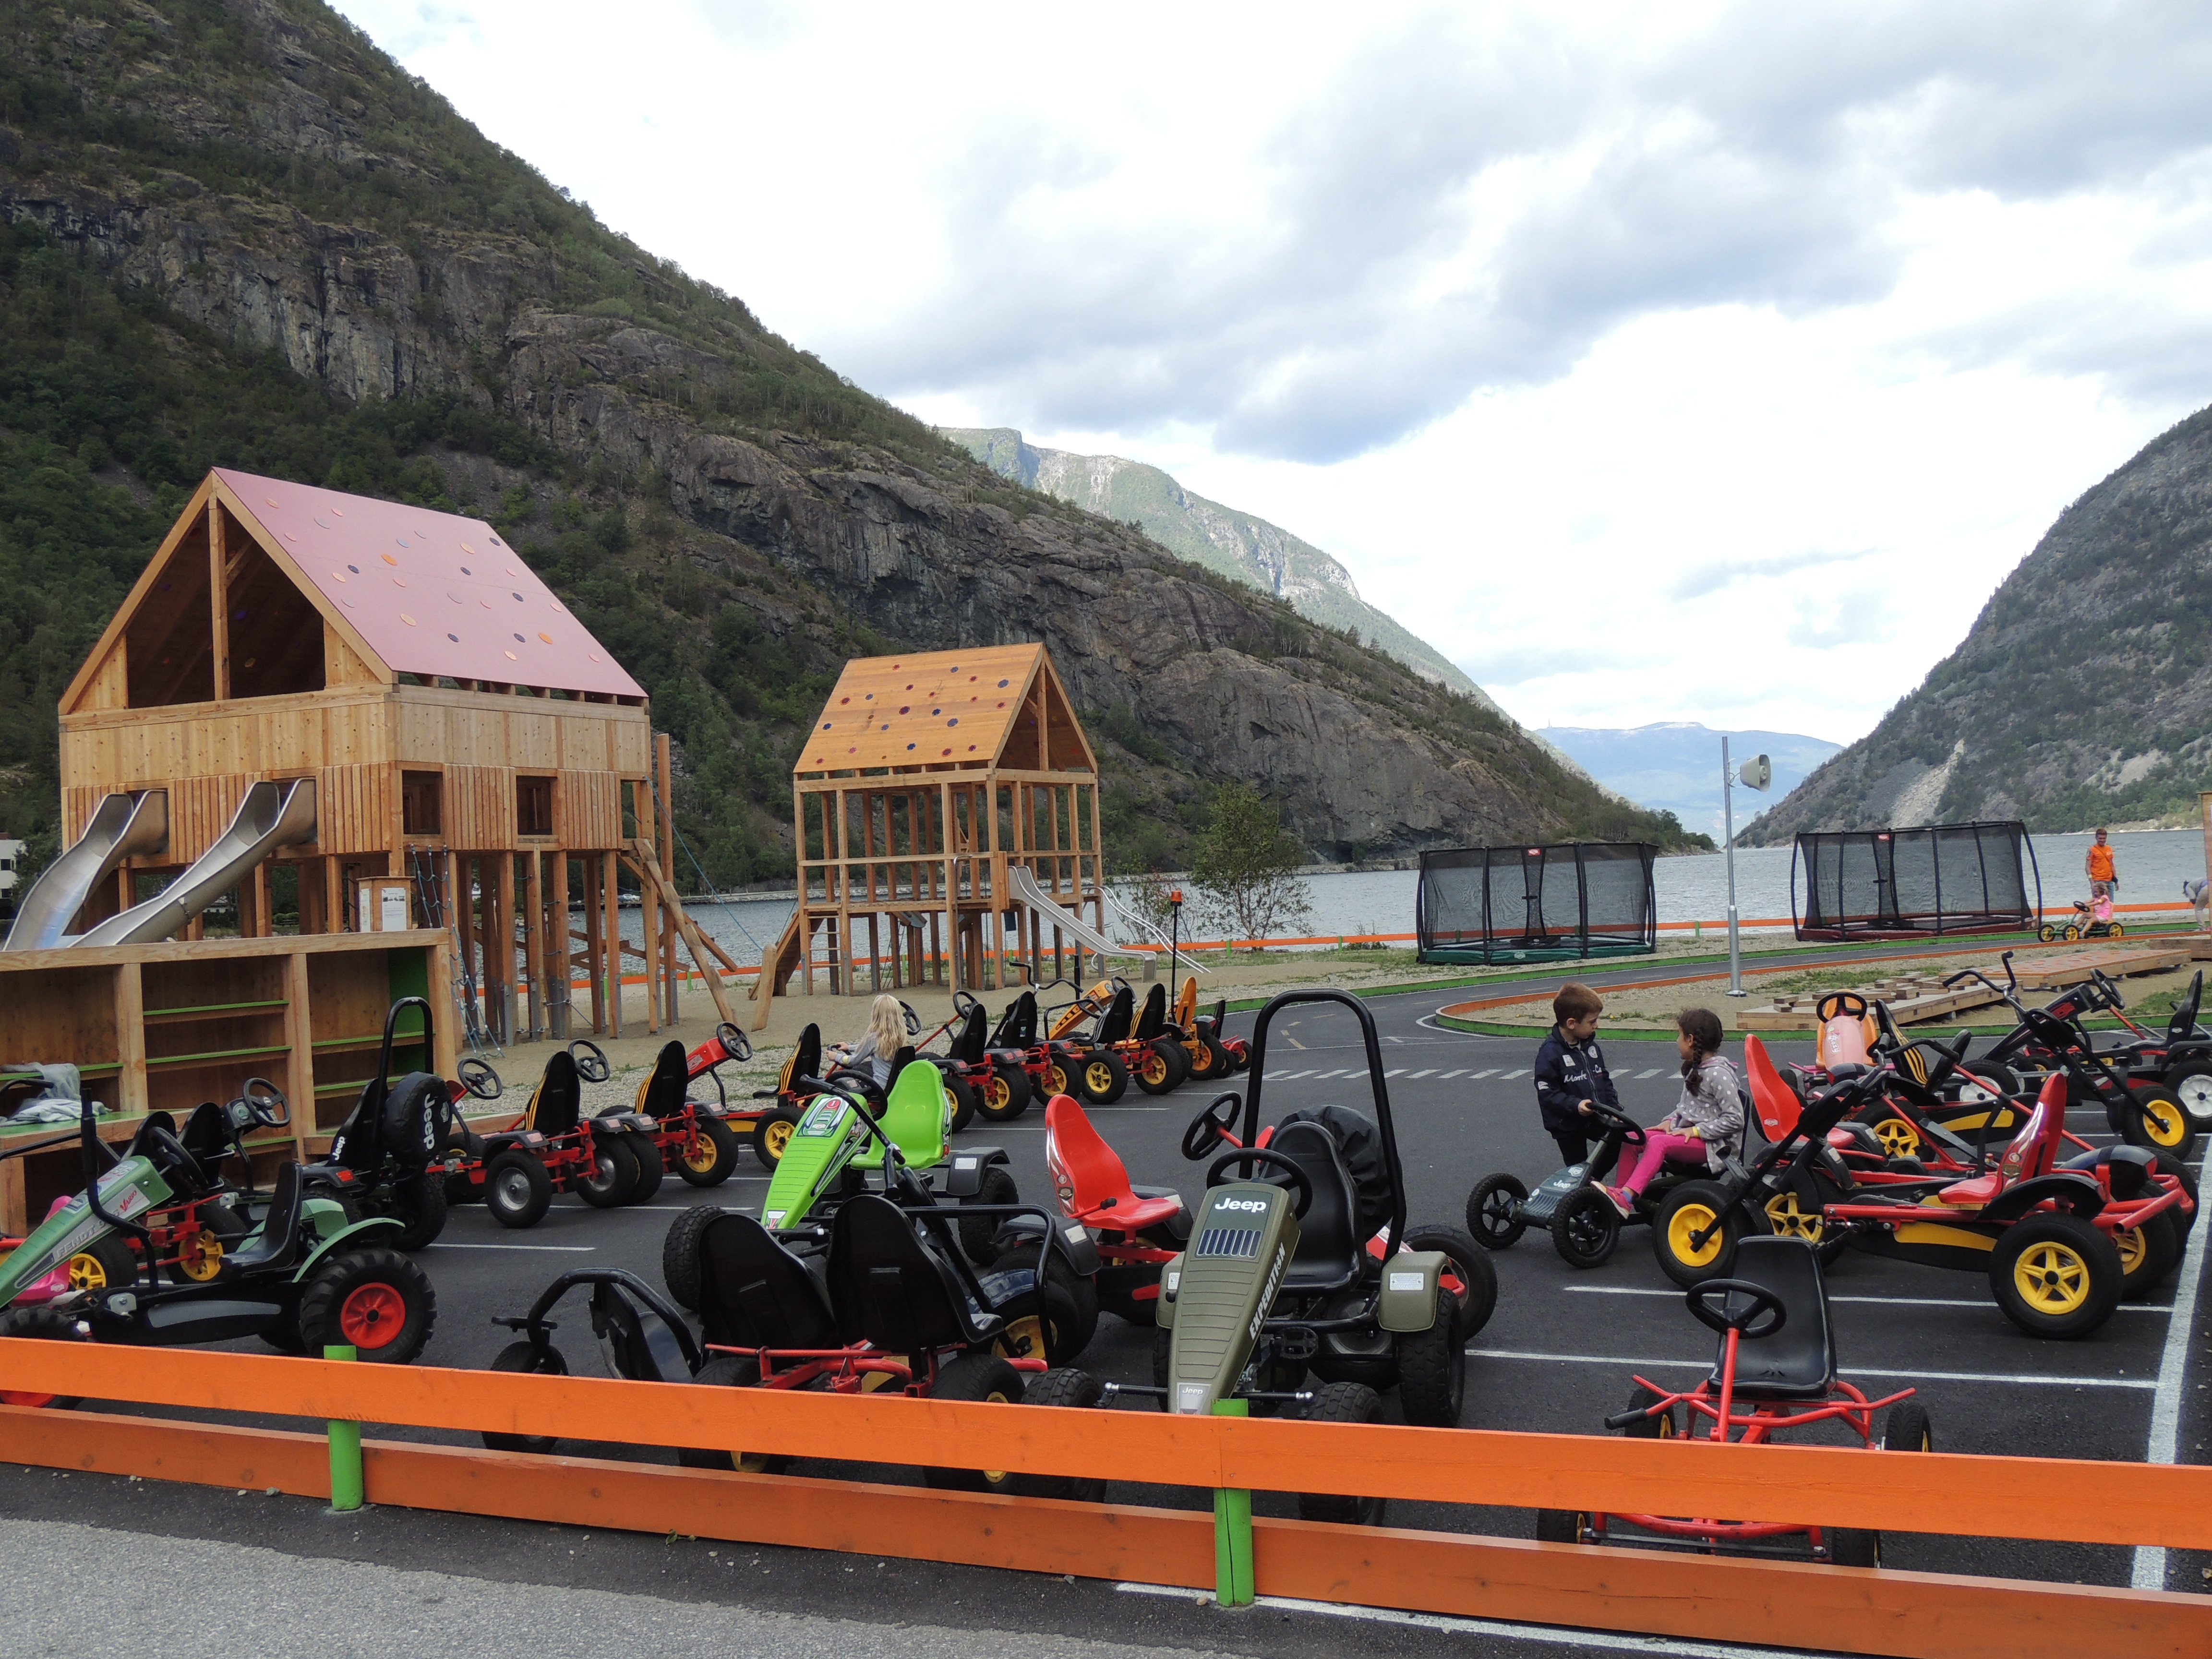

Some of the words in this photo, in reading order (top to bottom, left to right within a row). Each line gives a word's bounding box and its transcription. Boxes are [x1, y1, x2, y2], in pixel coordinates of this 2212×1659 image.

[423, 1093, 435, 1150] Jeep
[332, 1136, 346, 1160] Jeep
[1553, 1179, 1571, 1189] Jeep
[1214, 1198, 1266, 1213] Jeep
[57, 1224, 96, 1258] FENDT
[120, 1190, 137, 1212] VARIO
[1182, 1387, 1203, 1395] Jeep
